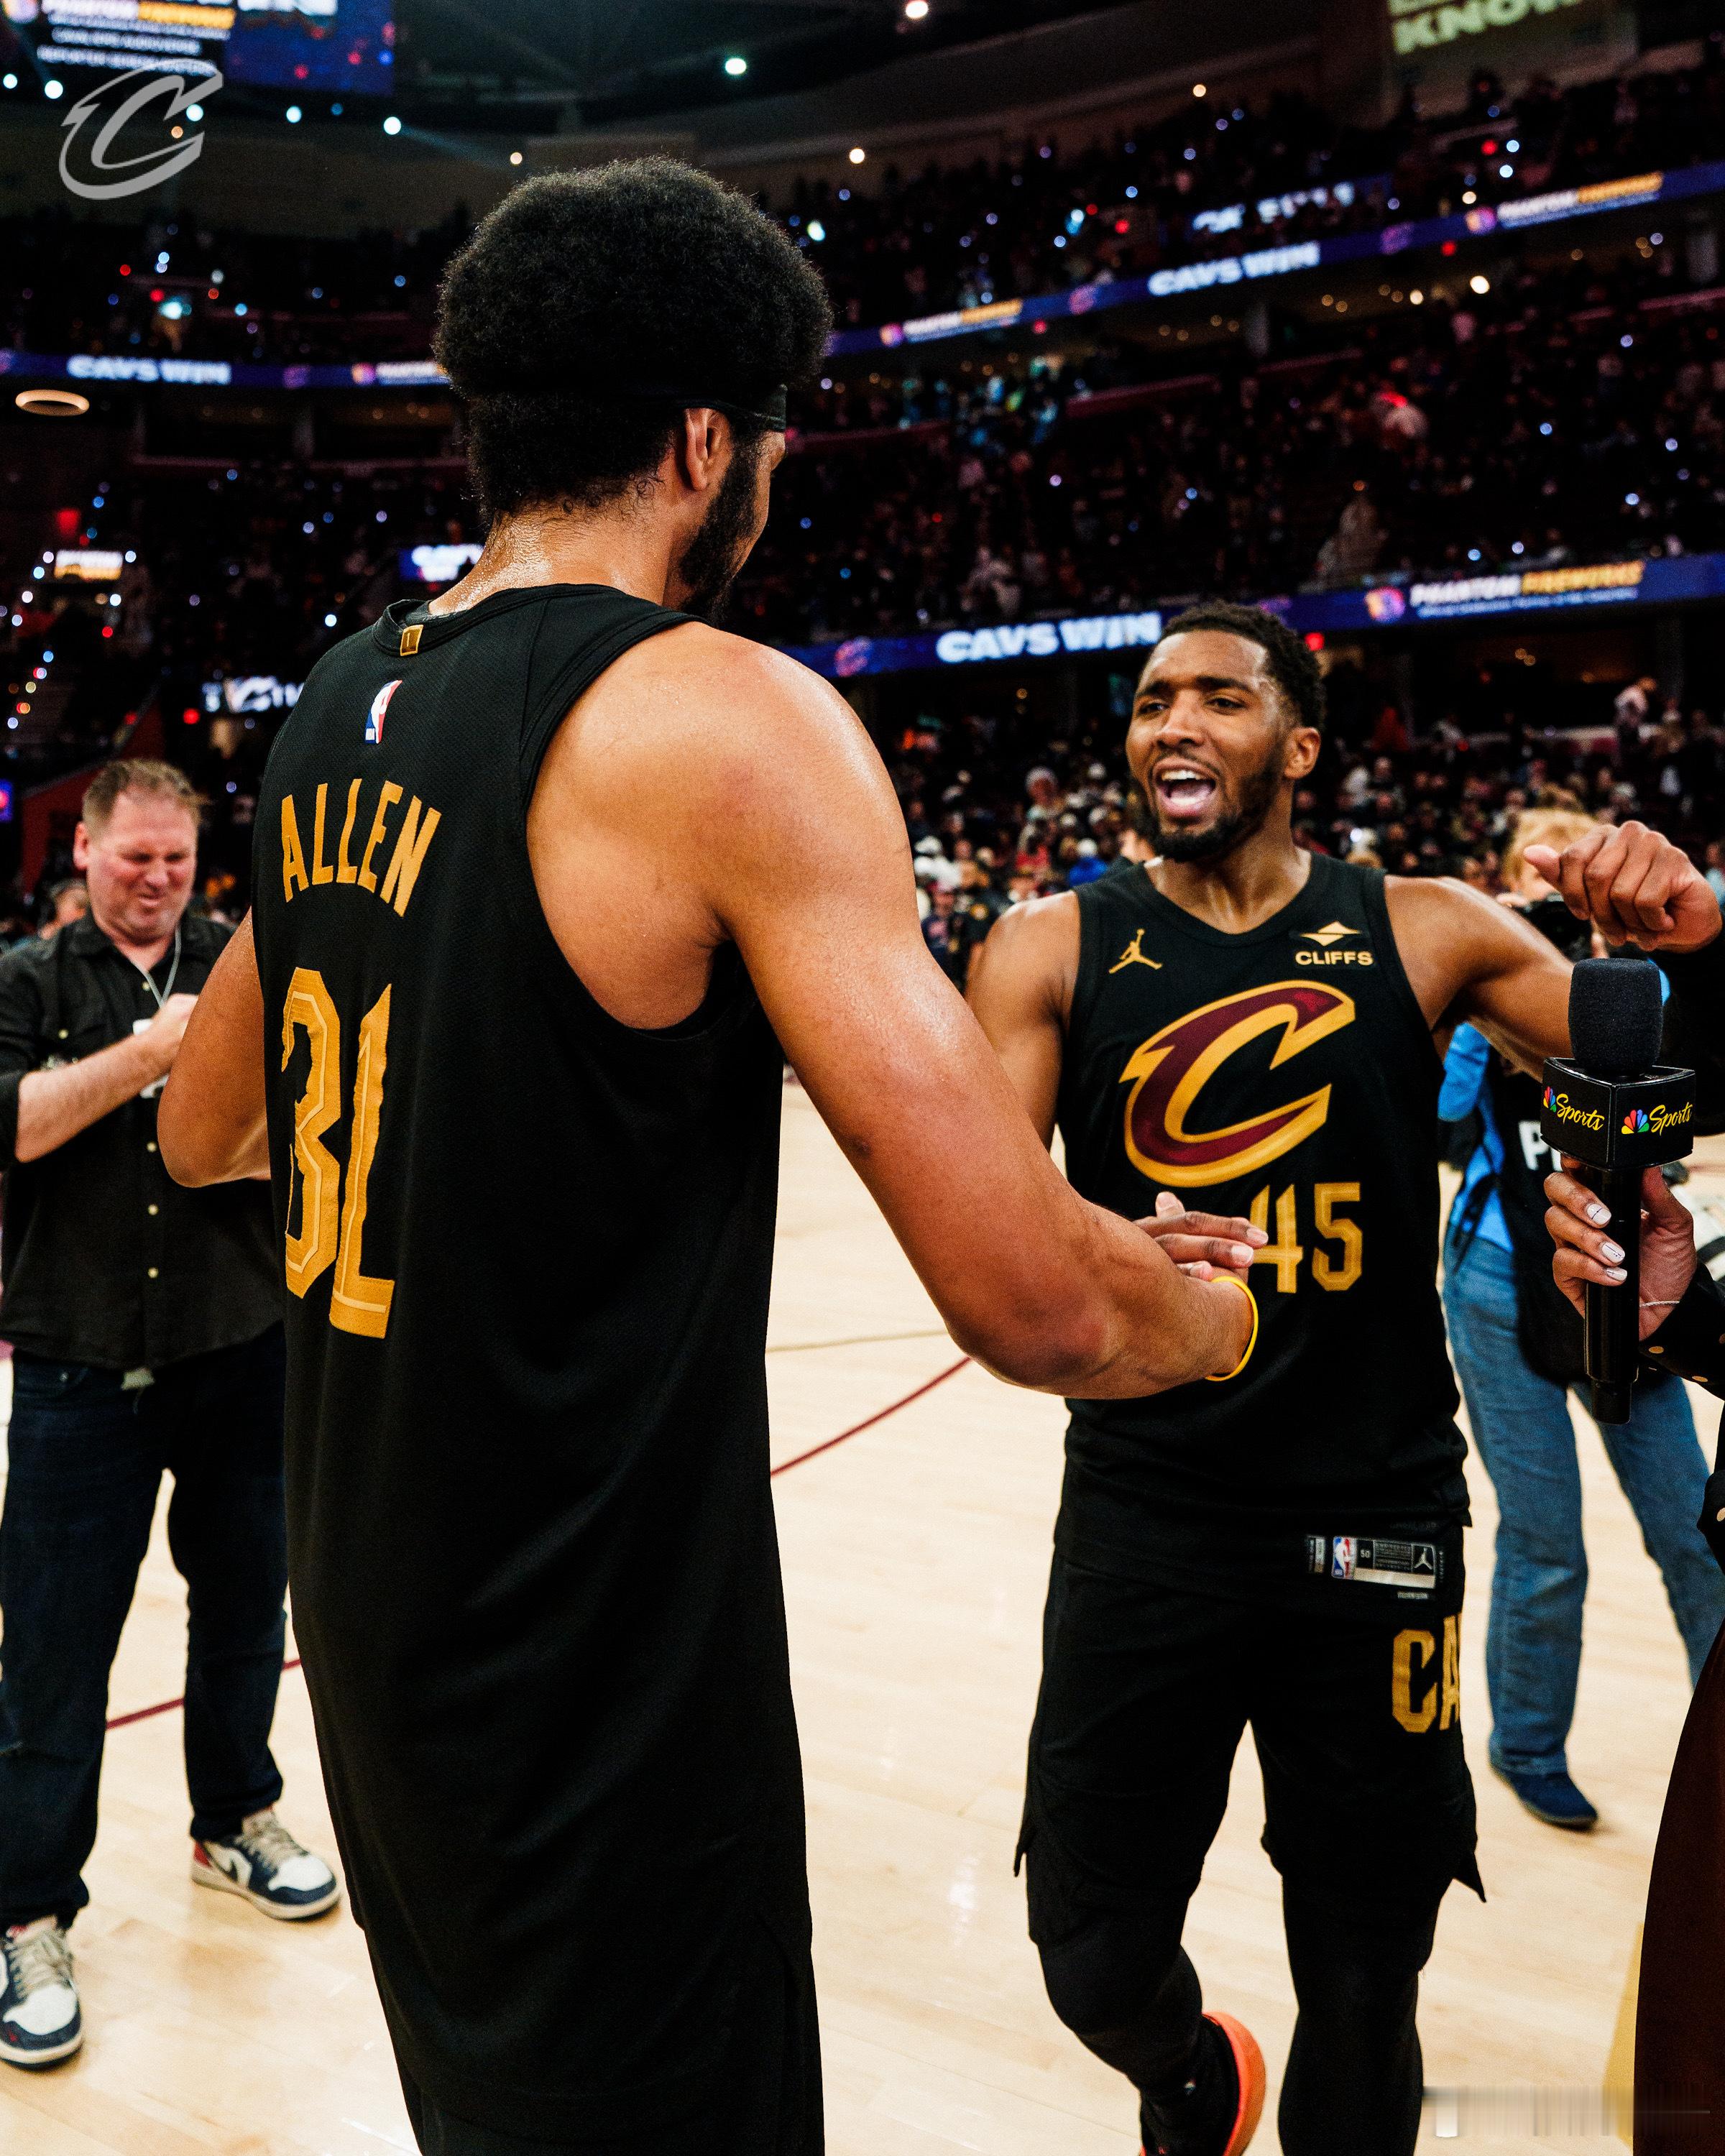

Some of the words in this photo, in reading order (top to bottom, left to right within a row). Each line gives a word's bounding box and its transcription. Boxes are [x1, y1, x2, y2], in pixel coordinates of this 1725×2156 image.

[935, 622, 1061, 663] CAVS
[1058, 611, 1162, 651] WIN
[281, 778, 442, 917] ALLEN
[1295, 950, 1374, 966] CLIFFS
[282, 967, 395, 1339] 31
[1556, 1093, 1605, 1131] Sports
[1649, 1102, 1693, 1136] Sports
[1250, 1181, 1363, 1293] 45
[1392, 1612, 1460, 1733] CA
